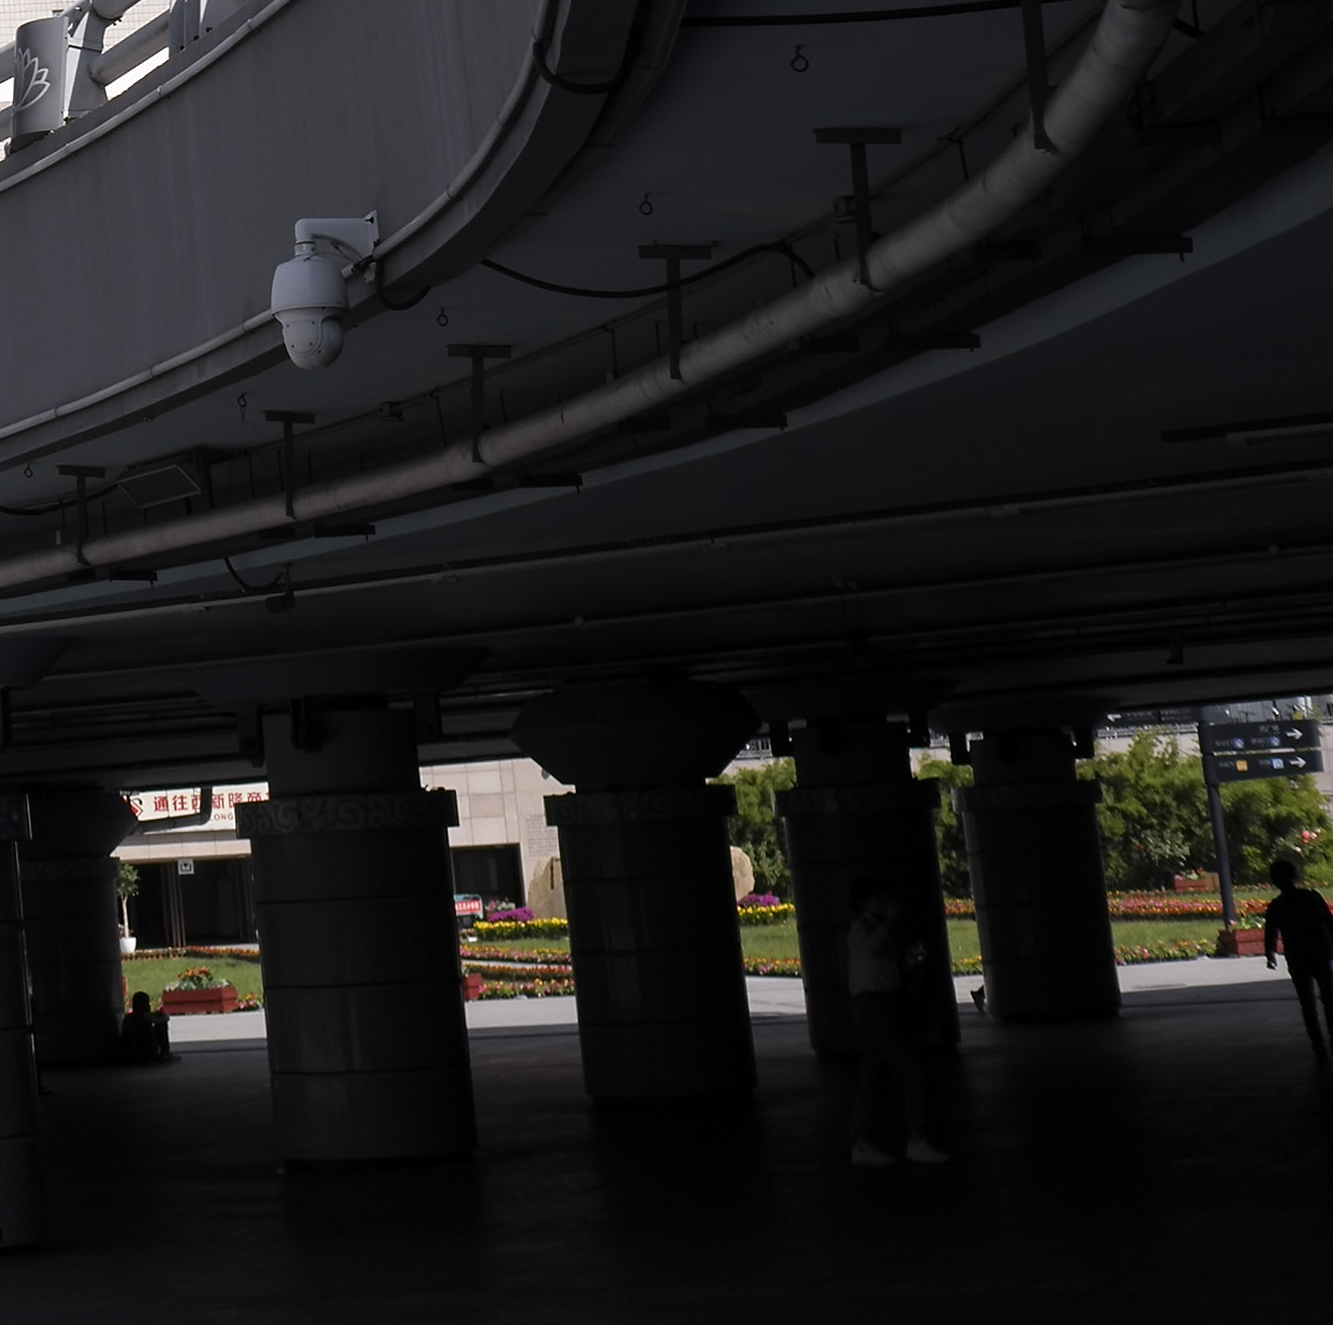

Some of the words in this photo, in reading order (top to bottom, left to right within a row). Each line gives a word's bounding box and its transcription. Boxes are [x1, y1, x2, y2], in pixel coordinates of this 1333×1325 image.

[153, 792, 269, 812] 通往西新隆商
